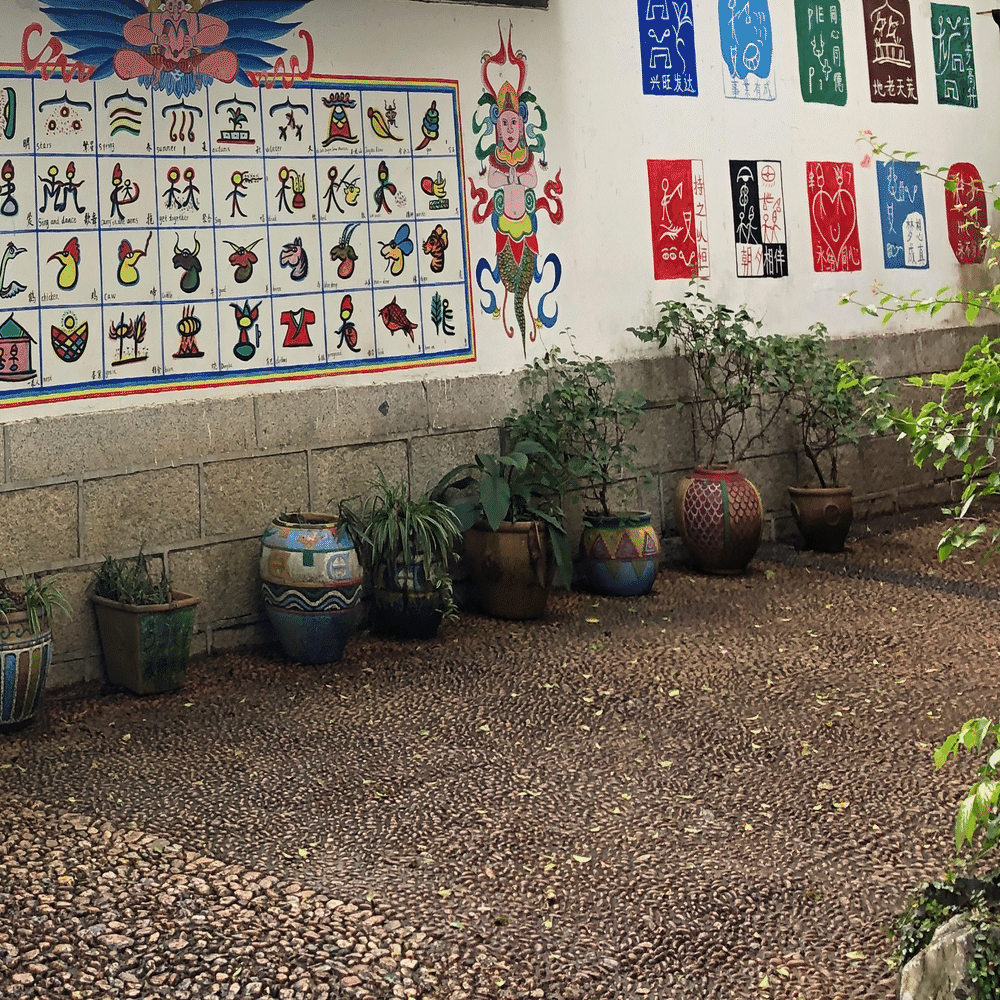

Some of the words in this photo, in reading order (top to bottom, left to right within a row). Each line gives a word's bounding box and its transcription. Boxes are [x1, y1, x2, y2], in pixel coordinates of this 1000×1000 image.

[650, 72, 697, 94] 兴旺发达
[873, 75, 918, 101] 地老天荒
[23, 137, 31, 150] 明
[694, 174, 709, 272] 持之以恒
[741, 245, 785, 276] 朝夕相伴
